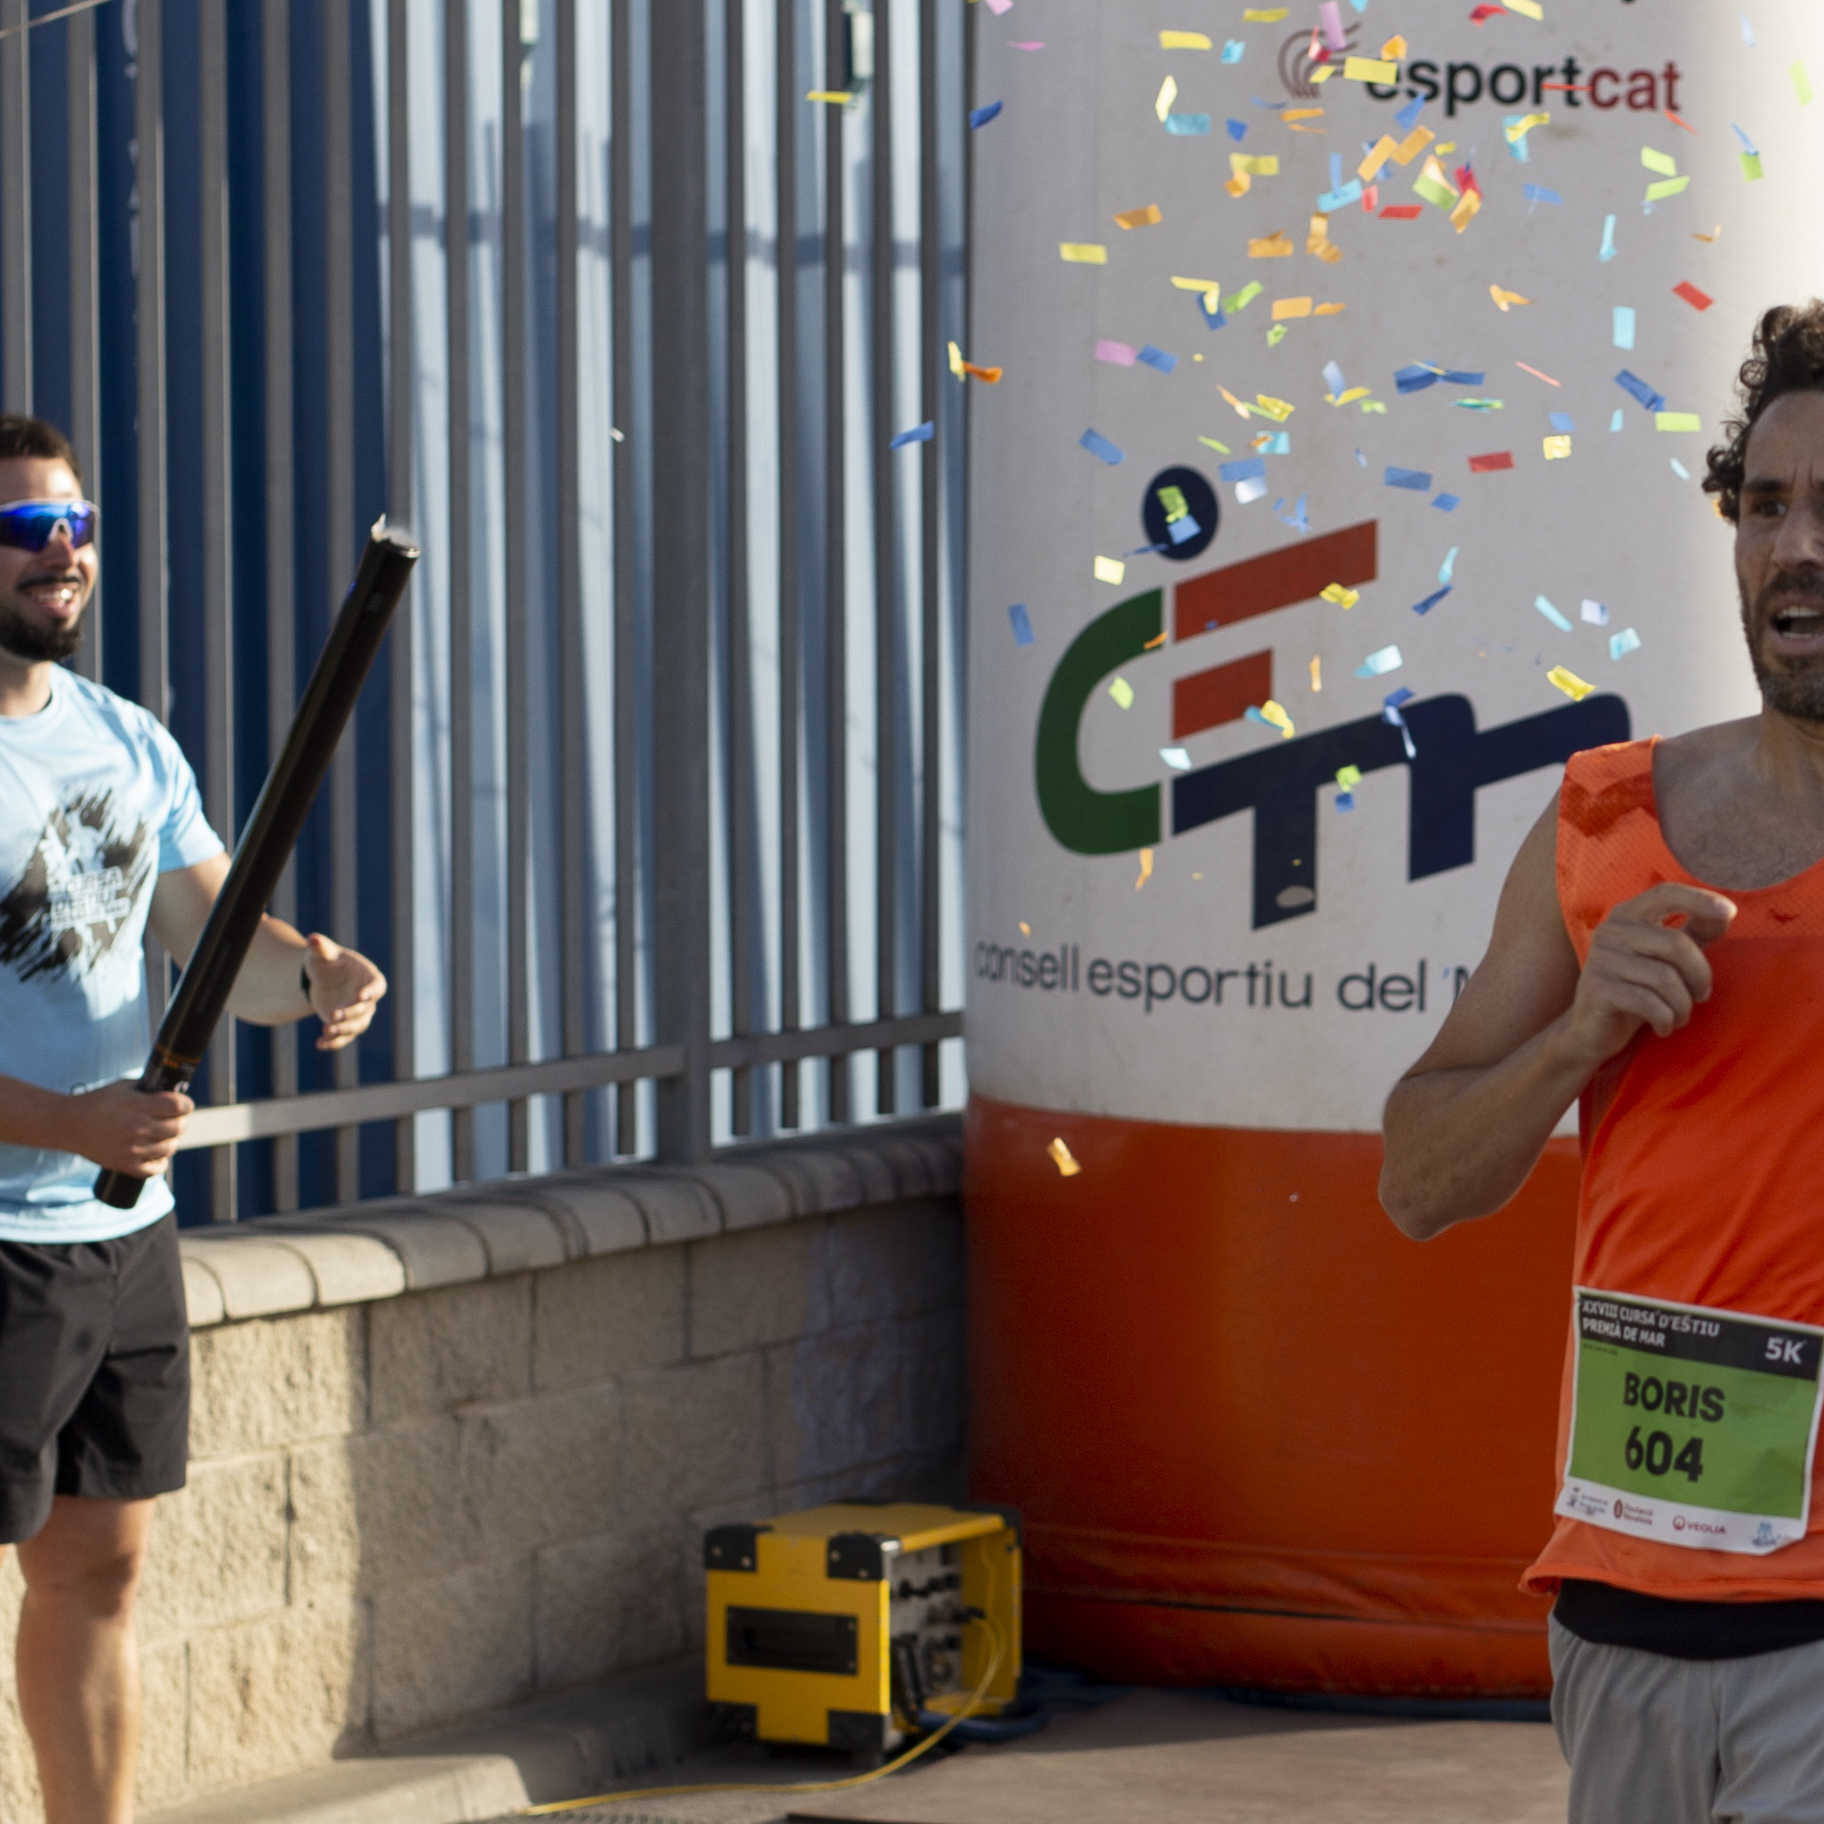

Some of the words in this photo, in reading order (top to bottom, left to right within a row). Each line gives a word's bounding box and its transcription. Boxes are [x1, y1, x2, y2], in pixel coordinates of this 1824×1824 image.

[975, 941, 1080, 993] consell
[1087, 957, 1312, 1014] esportiu
[1337, 958, 1426, 1013] del
[1620, 1306, 1656, 1326] CURSA
[1623, 1326, 1639, 1342] DE
[1639, 1329, 1666, 1348] MAR
[1765, 1337, 1803, 1364] 5K
[1623, 1371, 1726, 1423] BORIS
[1624, 1425, 1704, 1483] 604
